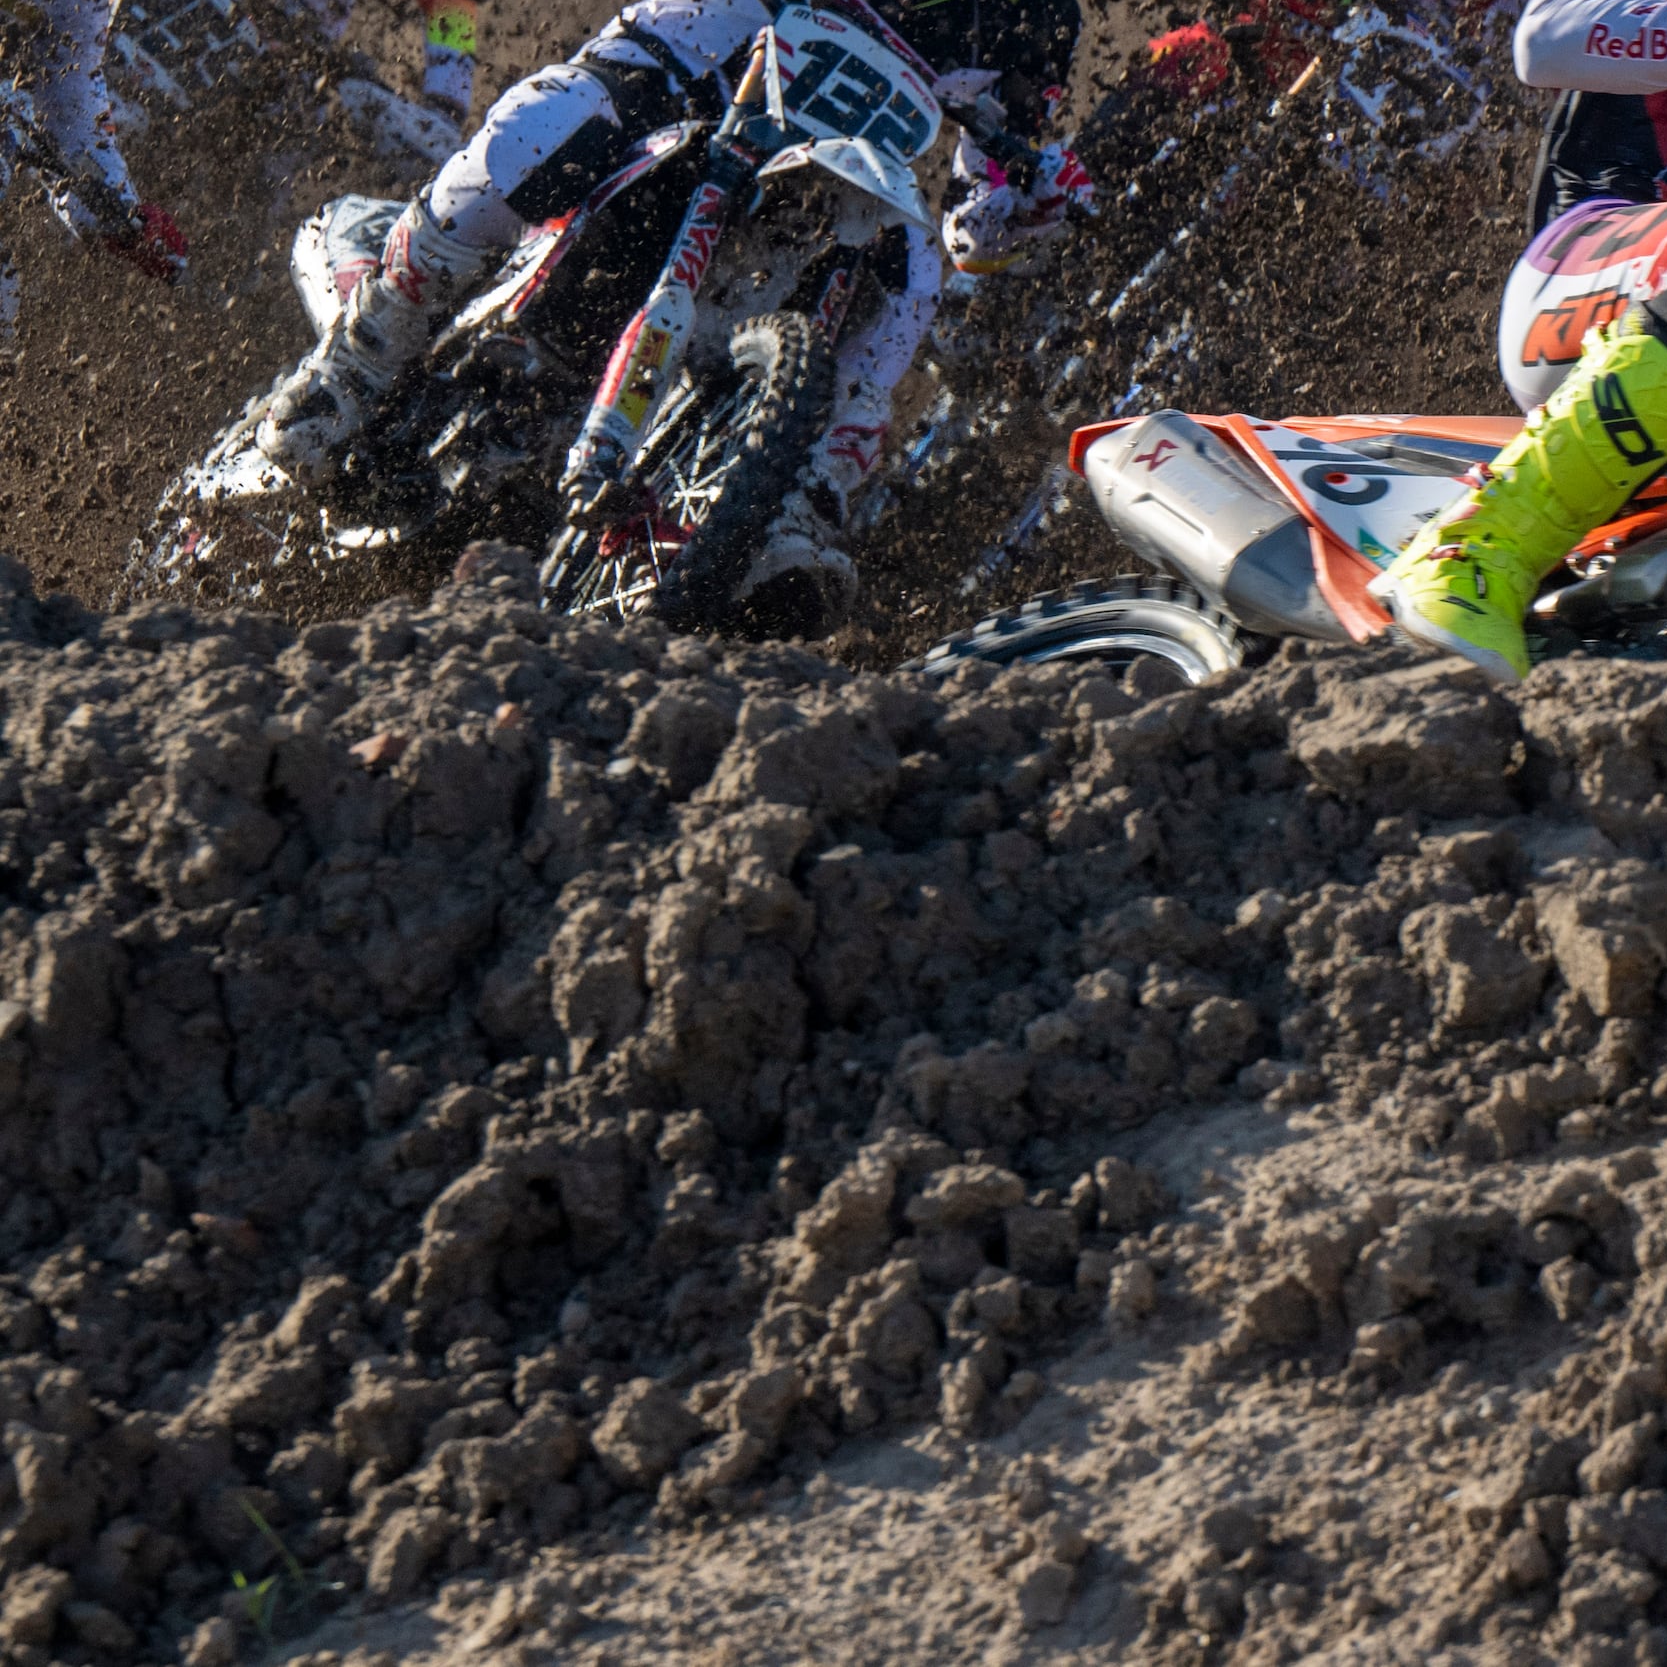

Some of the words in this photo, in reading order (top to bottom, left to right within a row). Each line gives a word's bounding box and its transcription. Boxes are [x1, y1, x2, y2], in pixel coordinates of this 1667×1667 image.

[1585, 23, 1646, 59] Red
[783, 38, 931, 166] 132
[1522, 285, 1631, 367] KT
